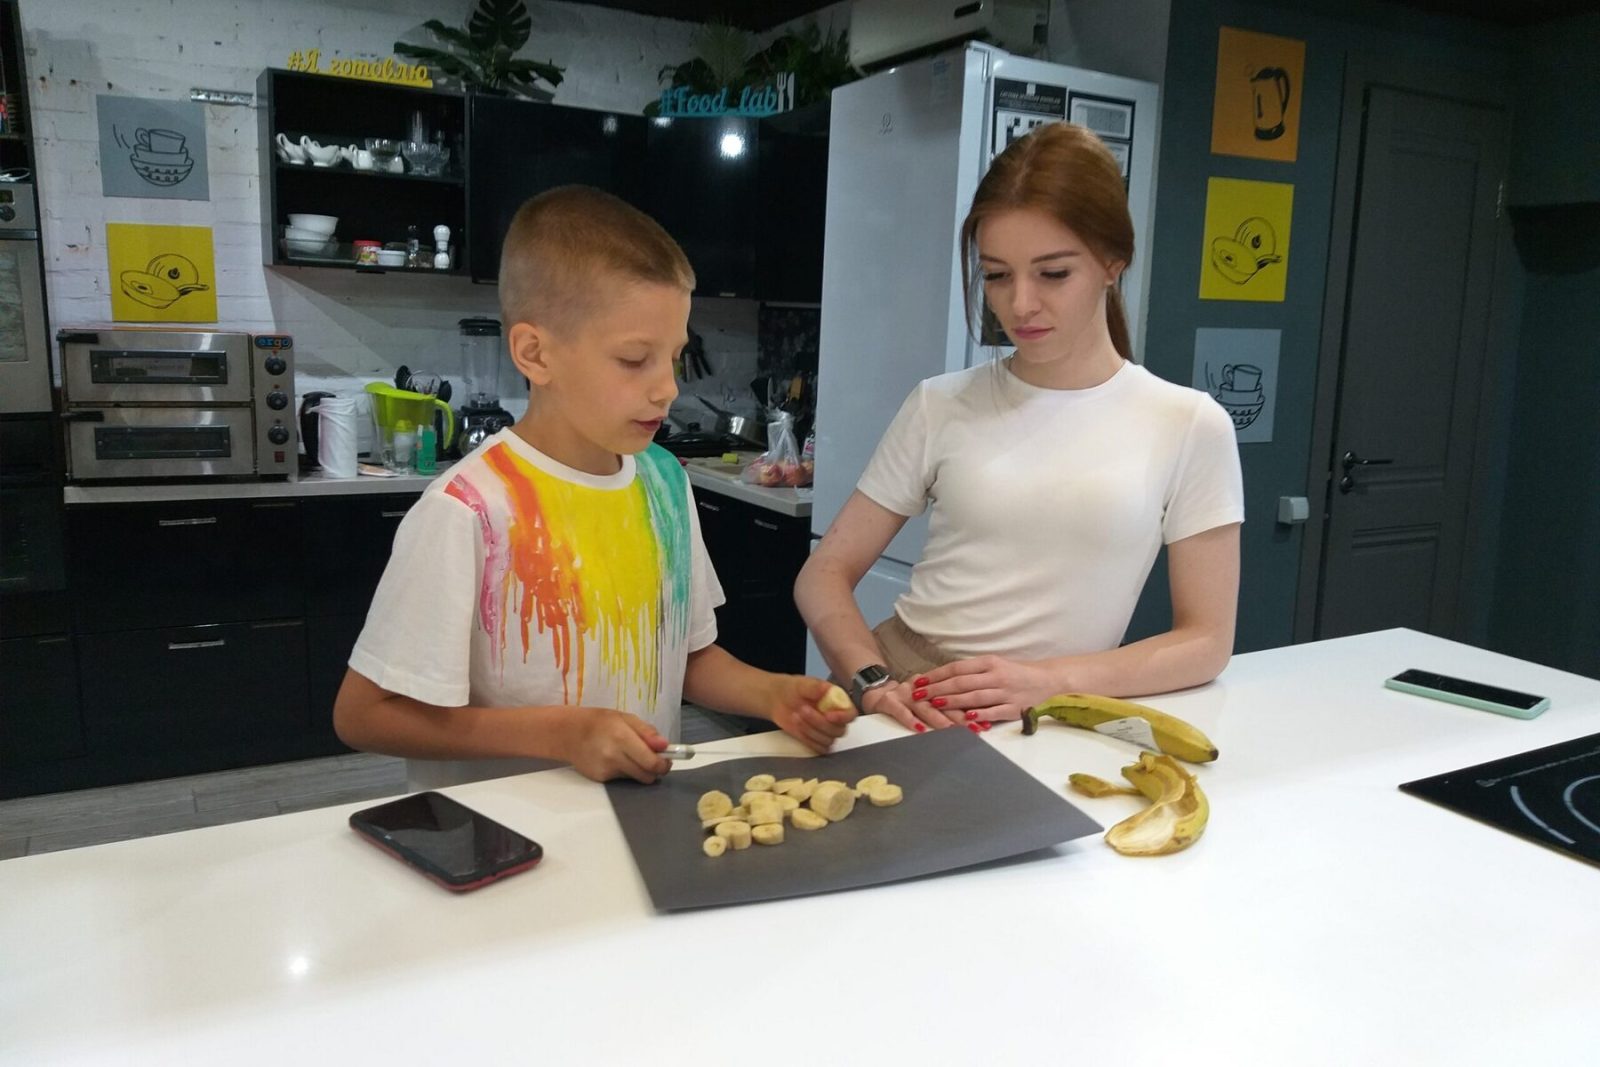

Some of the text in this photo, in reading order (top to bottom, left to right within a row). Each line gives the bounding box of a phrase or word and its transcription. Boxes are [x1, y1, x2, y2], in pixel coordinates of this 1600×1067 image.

[288, 48, 428, 82] #Я готовлю
[659, 85, 777, 115] #Food lab
